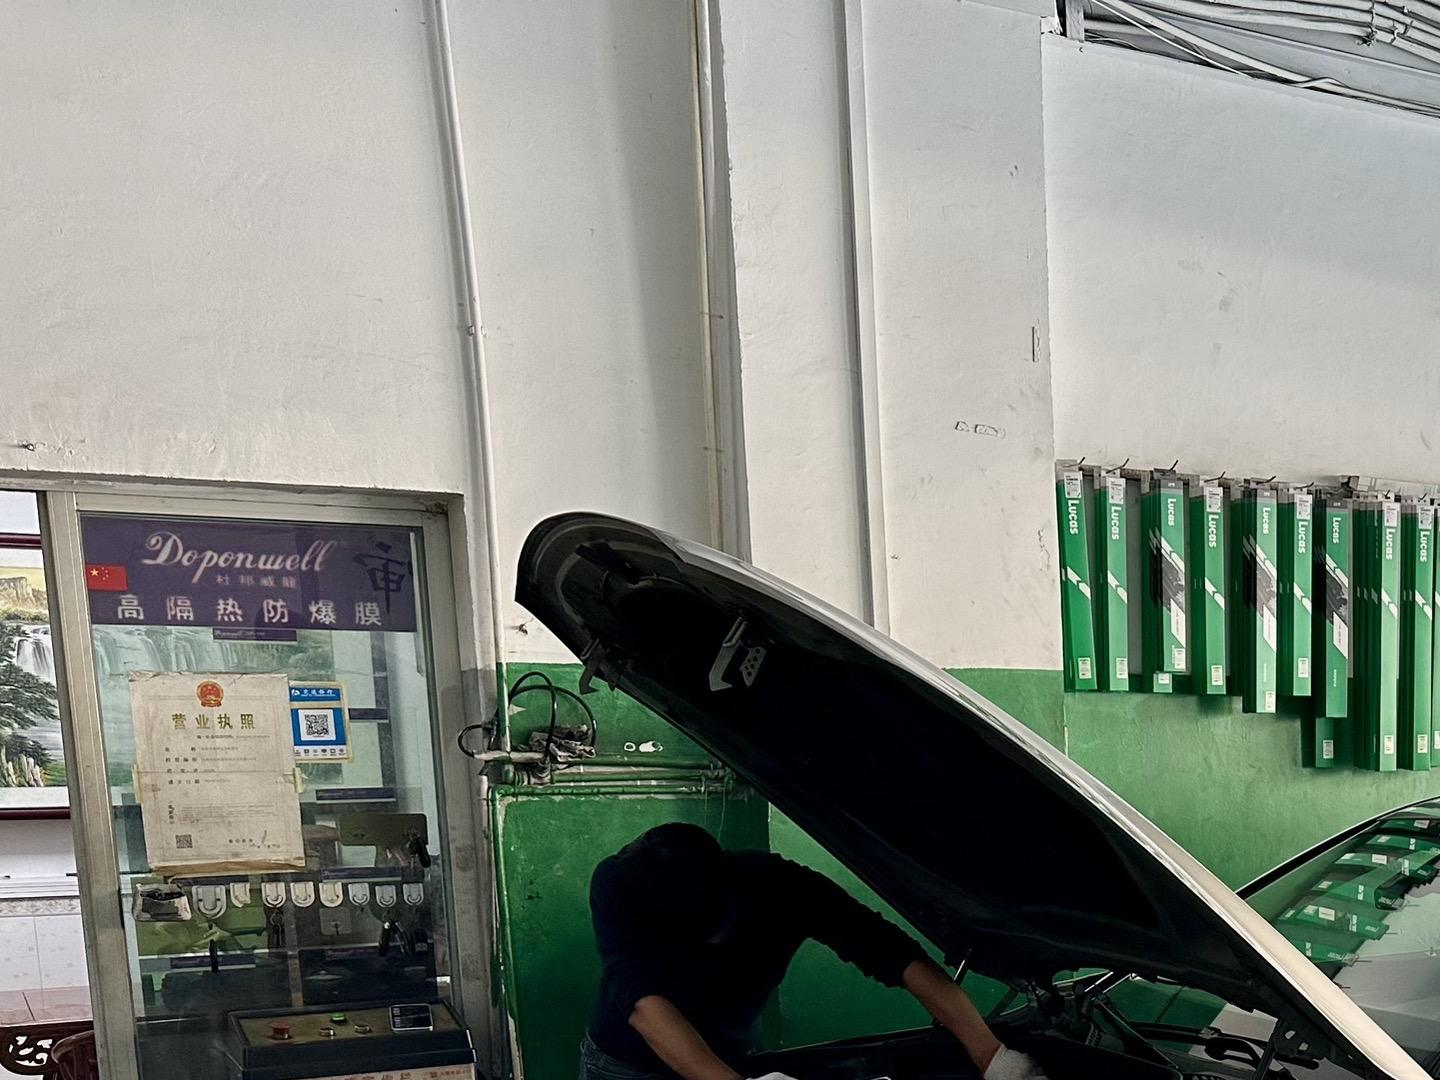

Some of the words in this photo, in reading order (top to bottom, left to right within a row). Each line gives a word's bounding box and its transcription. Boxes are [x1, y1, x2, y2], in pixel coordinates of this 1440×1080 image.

[1068, 500, 1079, 534] Lucas
[1111, 506, 1122, 540] Lucas
[1167, 498, 1176, 526] Lucas
[1263, 507, 1271, 534] Lucas
[1208, 514, 1219, 548] Lucas
[1298, 521, 1308, 554] Lucas
[1332, 517, 1341, 544] Lucas
[1385, 528, 1395, 560] Lucas
[1419, 531, 1430, 562] Lucas
[142, 531, 336, 583] Doponwell
[117, 594, 381, 626] 高隔热防爆膜
[171, 713, 255, 730] 营业执照
